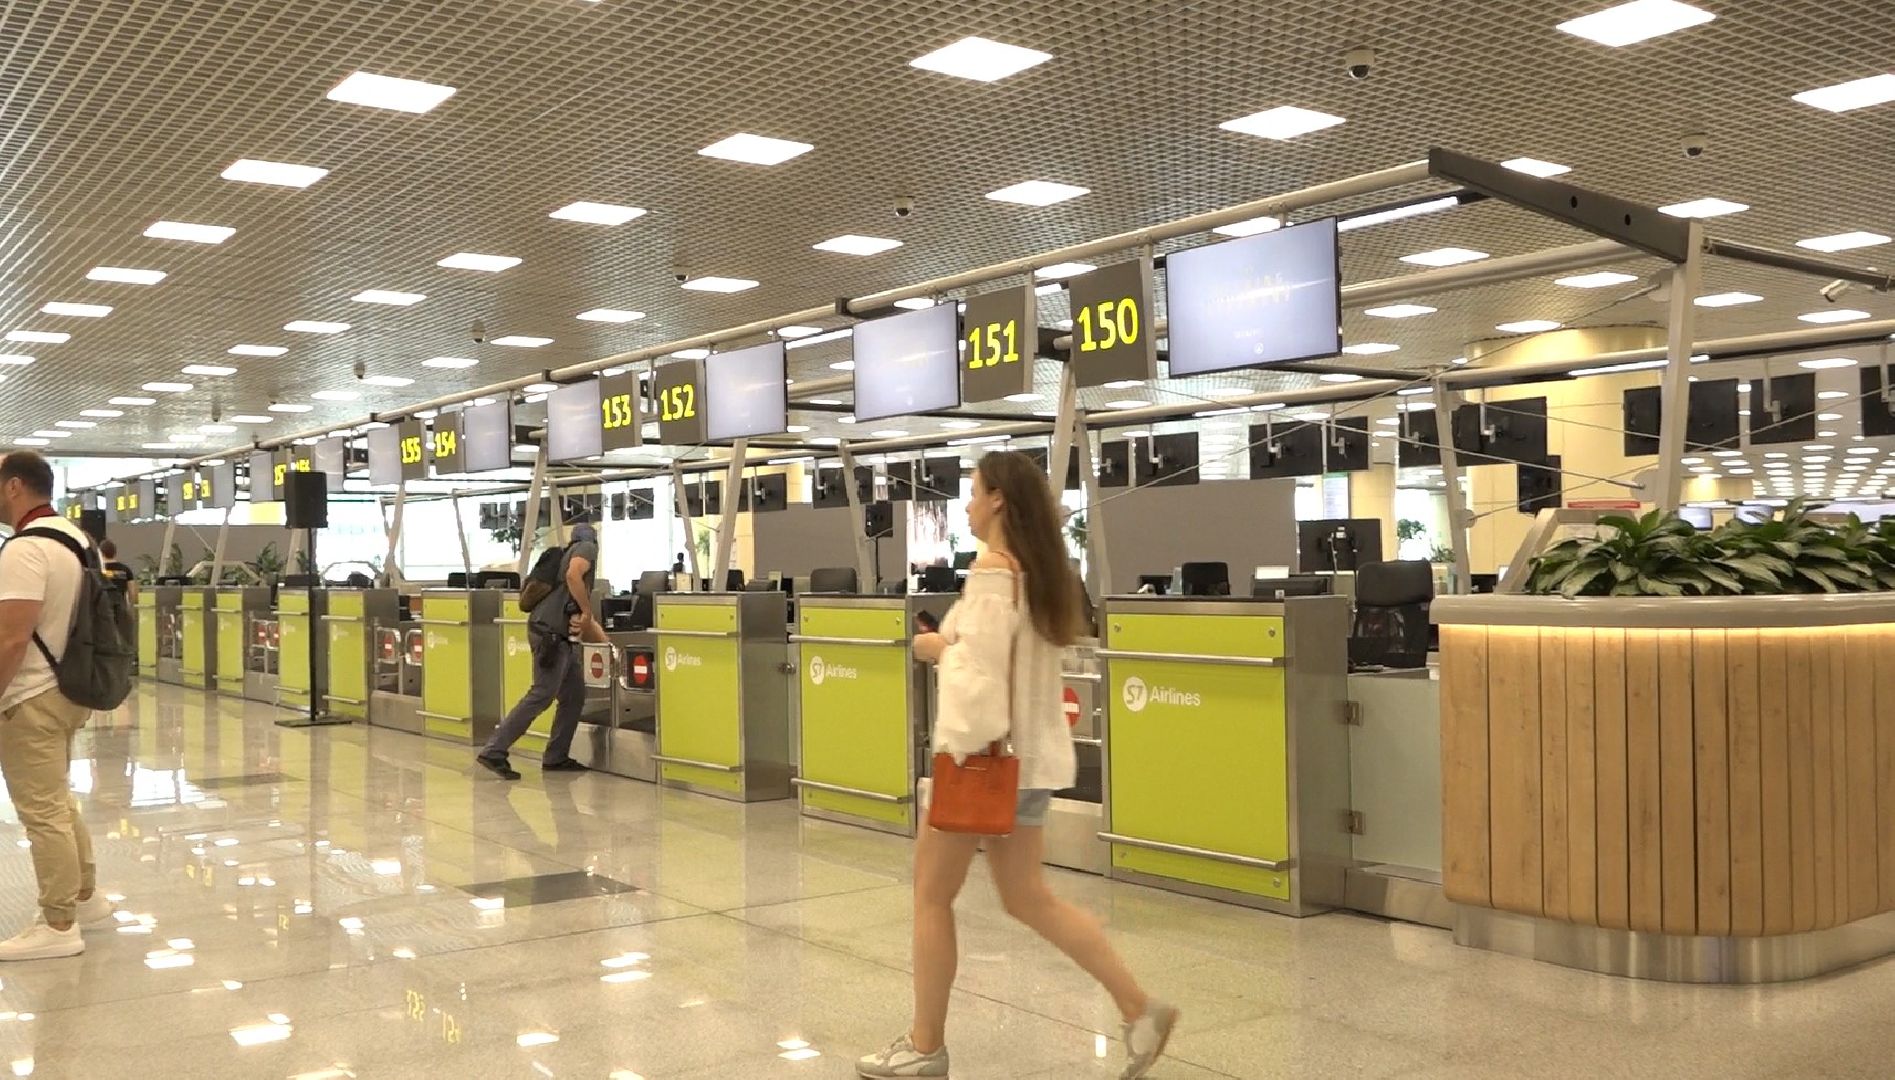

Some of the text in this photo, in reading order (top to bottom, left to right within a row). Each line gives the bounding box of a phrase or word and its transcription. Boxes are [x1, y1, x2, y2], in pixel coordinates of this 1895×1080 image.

[1078, 298, 1138, 352] 150
[968, 321, 1019, 369] 151
[602, 394, 632, 429] 153
[661, 383, 695, 421] 152
[401, 437, 421, 464] 155
[434, 431, 456, 458] 154
[825, 663, 857, 681] Airlines
[1149, 685, 1201, 707] Airlines
